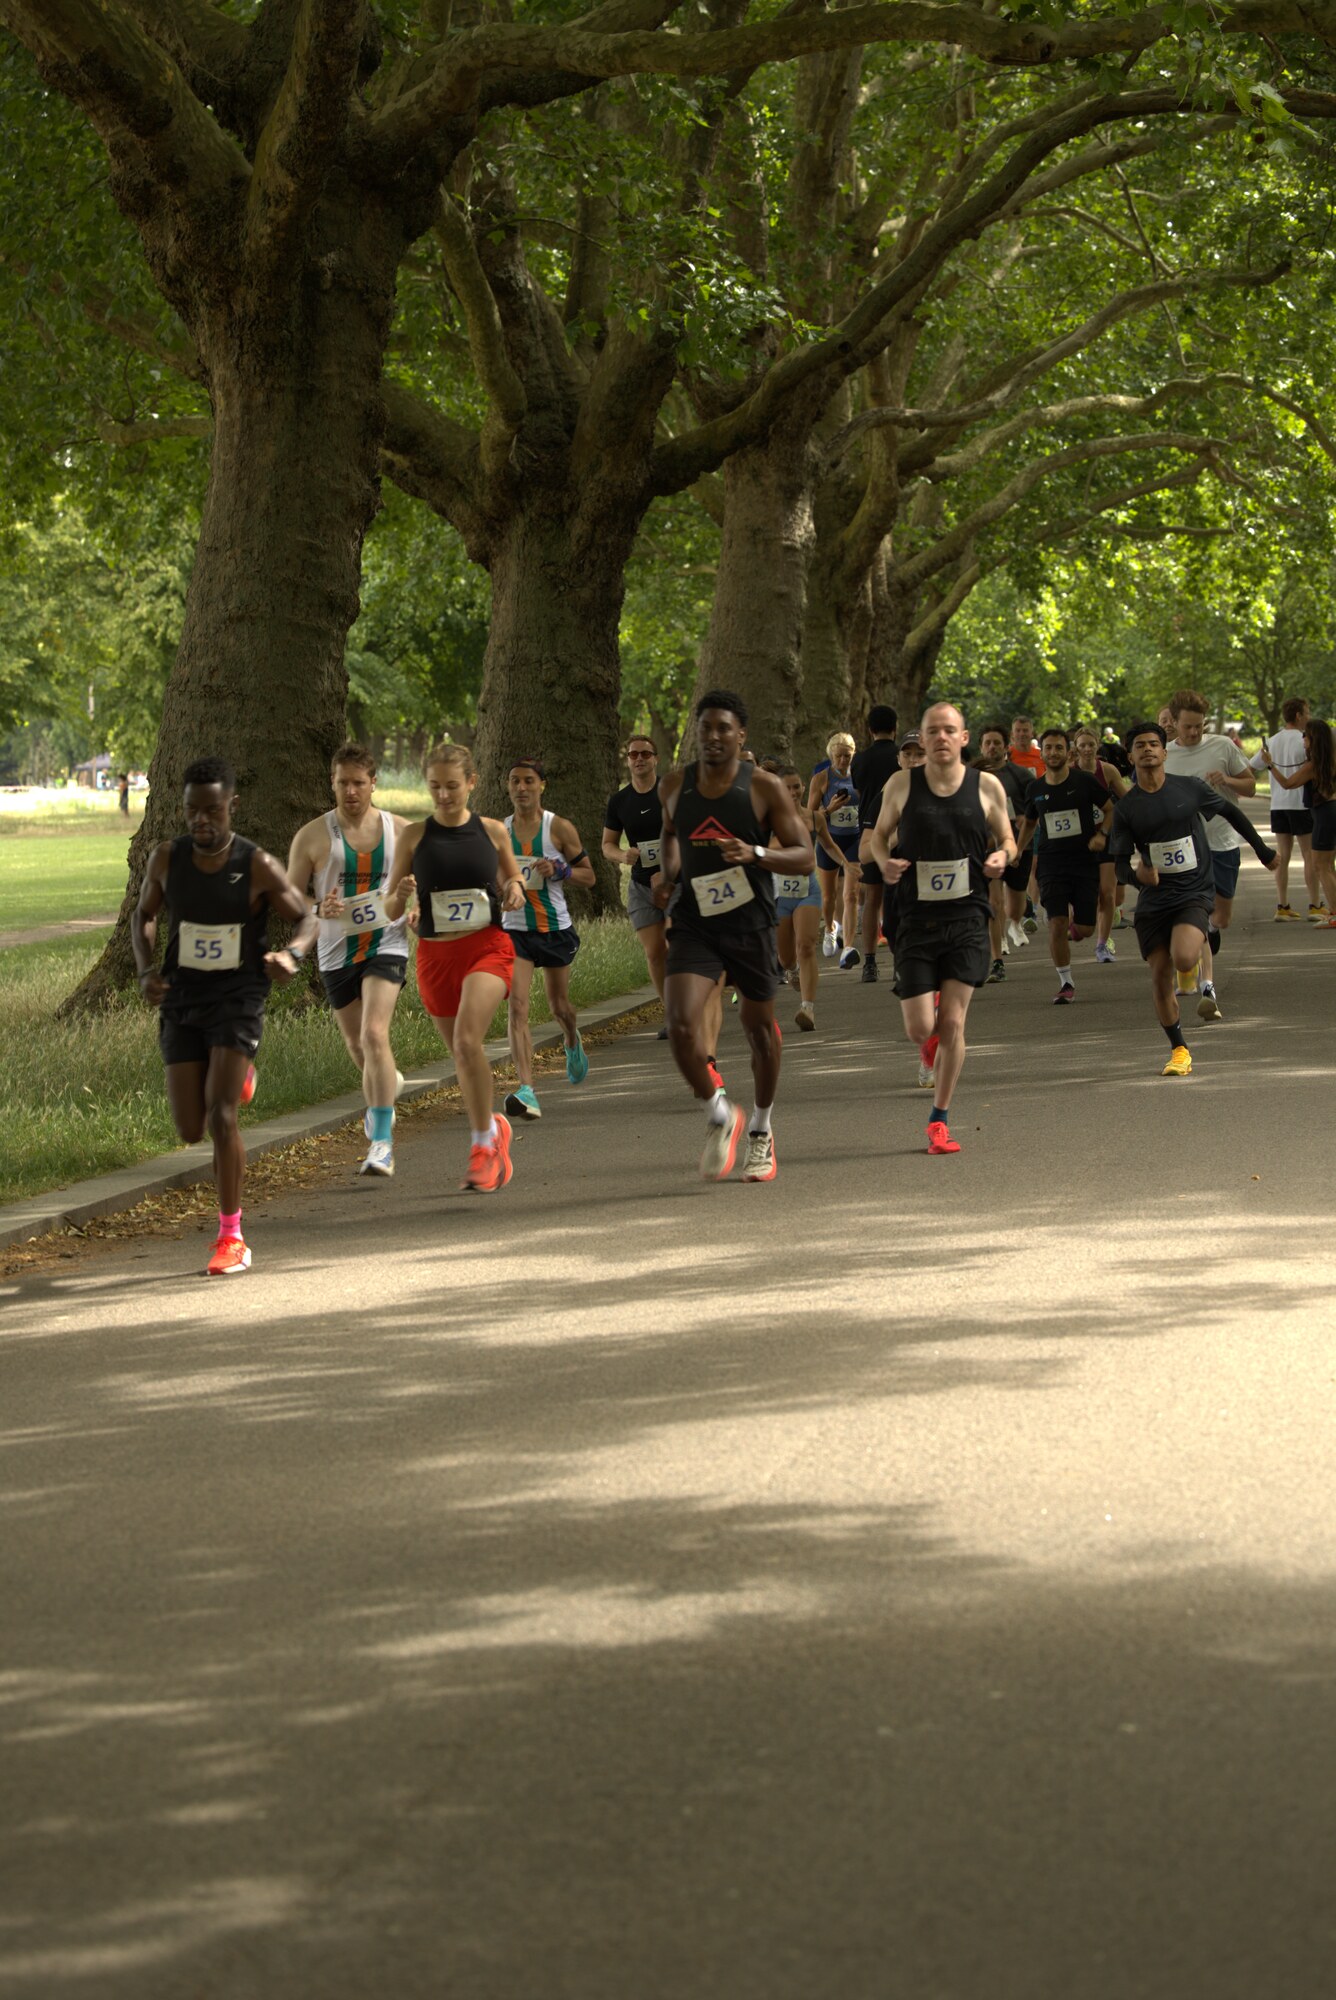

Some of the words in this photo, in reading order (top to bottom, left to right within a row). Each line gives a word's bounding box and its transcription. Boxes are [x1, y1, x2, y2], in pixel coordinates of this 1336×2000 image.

[838, 812, 852, 823] 34
[1055, 818, 1071, 832] 53
[647, 848, 660, 861] 5
[1163, 849, 1185, 867] 36
[783, 880, 800, 892] 52
[931, 873, 956, 891] 67
[707, 882, 735, 904] 24
[352, 904, 376, 924] 65
[448, 902, 474, 921] 27
[194, 939, 222, 959] 55
